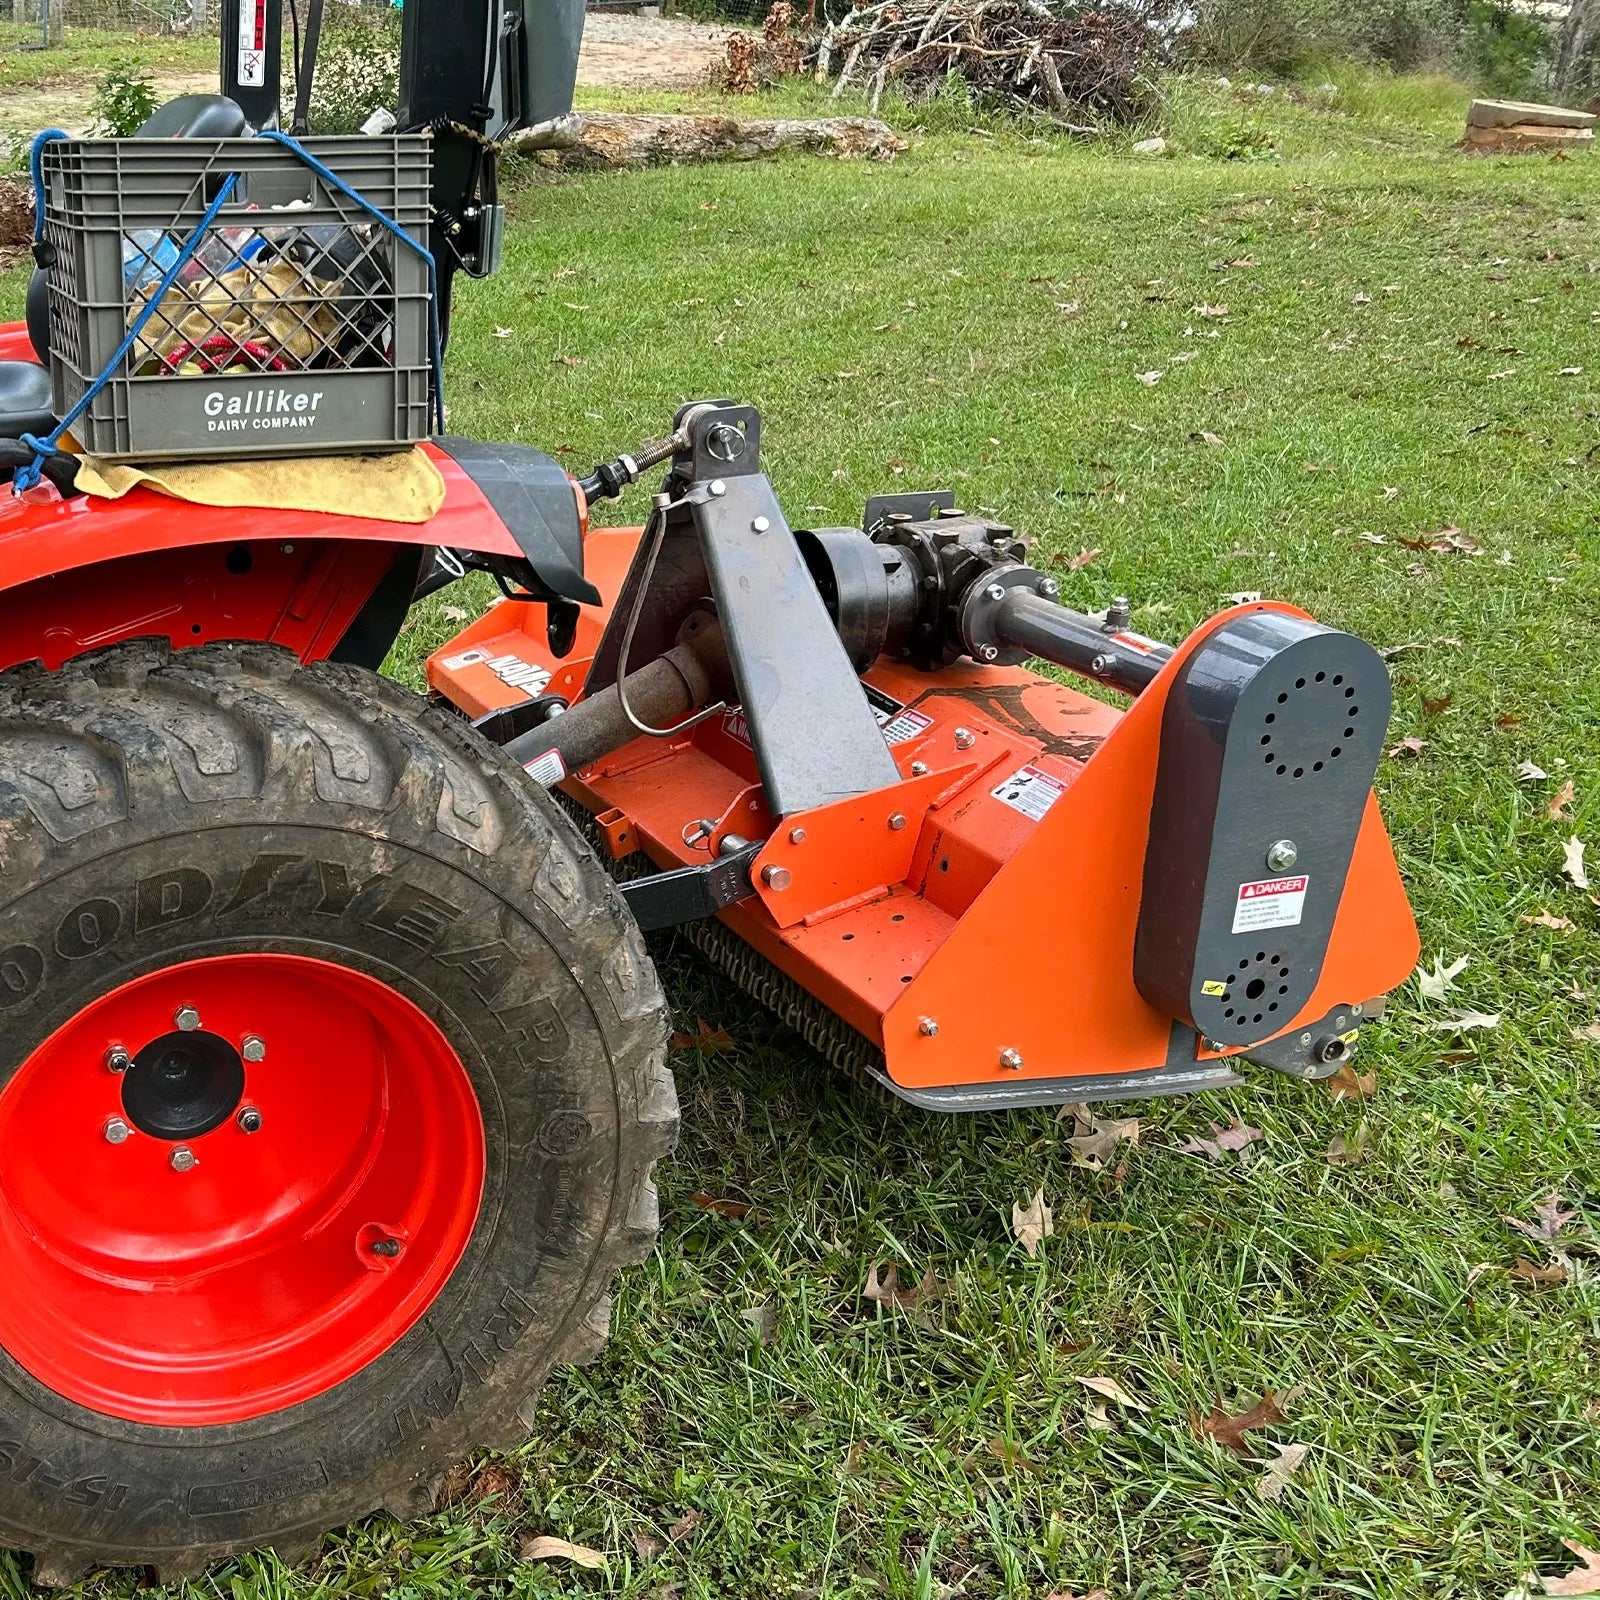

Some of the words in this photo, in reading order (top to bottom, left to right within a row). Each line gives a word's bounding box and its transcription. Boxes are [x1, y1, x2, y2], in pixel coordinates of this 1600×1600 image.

[204, 389, 324, 416] Galliker
[207, 419, 248, 432] DAIRY
[252, 415, 316, 429] COMPANY
[1255, 879, 1302, 895] DANGER
